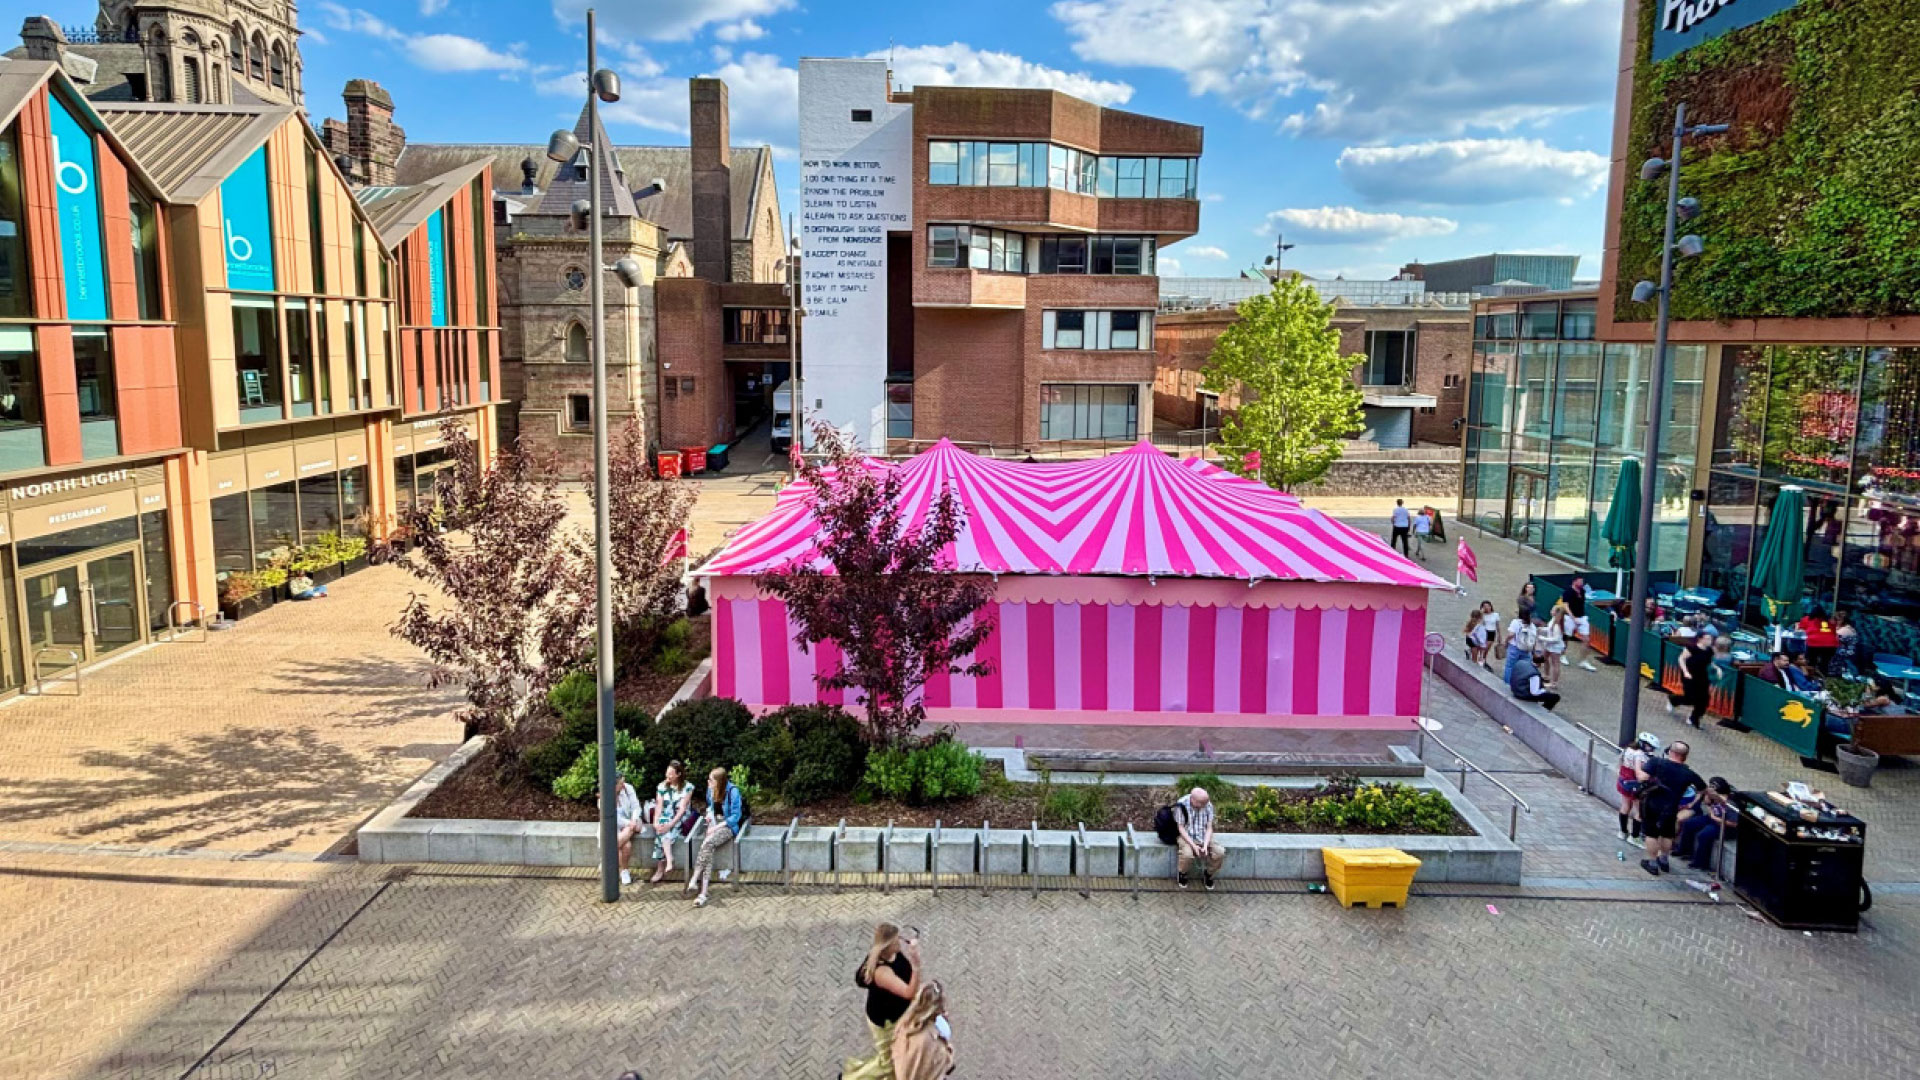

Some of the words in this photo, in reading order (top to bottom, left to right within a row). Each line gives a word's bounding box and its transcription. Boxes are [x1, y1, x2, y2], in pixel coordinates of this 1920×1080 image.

[803, 160, 819, 168] HOW
[821, 160, 832, 168] TO
[821, 175, 834, 183] ONE
[837, 175, 858, 183] THING
[860, 175, 869, 183] AT
[871, 175, 876, 183] A
[879, 175, 896, 185] TIME
[832, 188, 847, 196] THE
[849, 188, 885, 197] PROBLEM
[836, 200, 847, 208] TO
[849, 200, 877, 209] LISTEN
[837, 212, 847, 220] TO
[849, 212, 864, 220] ASK
[866, 212, 907, 221] QUESTIONS
[818, 236, 840, 244] FROM
[842, 236, 883, 244] NONSENSE
[811, 250, 838, 258] ACCEPT
[840, 250, 867, 258] CHANGE
[811, 271, 834, 279] ADMIT
[838, 271, 875, 279] MISTAKES
[830, 284, 837, 292] IT
[840, 284, 868, 292] SIMPLE
[826, 296, 847, 304] CALM
[12, 478, 77, 500] NORTH
[81, 469, 129, 488] LIGHT
[48, 506, 107, 524] RESTAURANT
